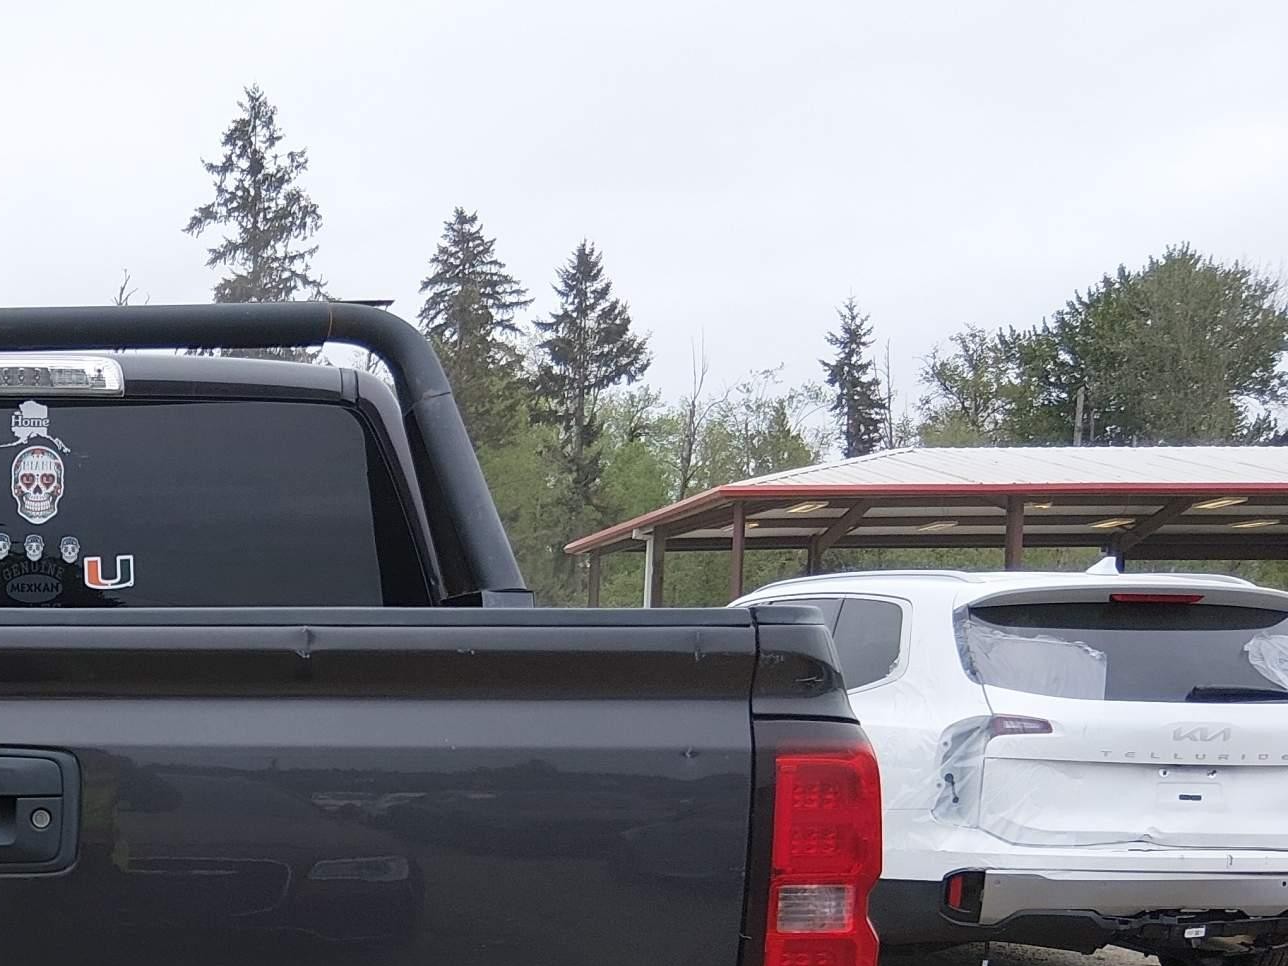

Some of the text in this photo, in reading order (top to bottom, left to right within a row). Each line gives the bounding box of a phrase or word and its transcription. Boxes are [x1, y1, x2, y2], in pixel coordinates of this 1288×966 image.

[11, 415, 50, 427] Home
[2, 560, 65, 581] GENUINE
[83, 555, 134, 589] U
